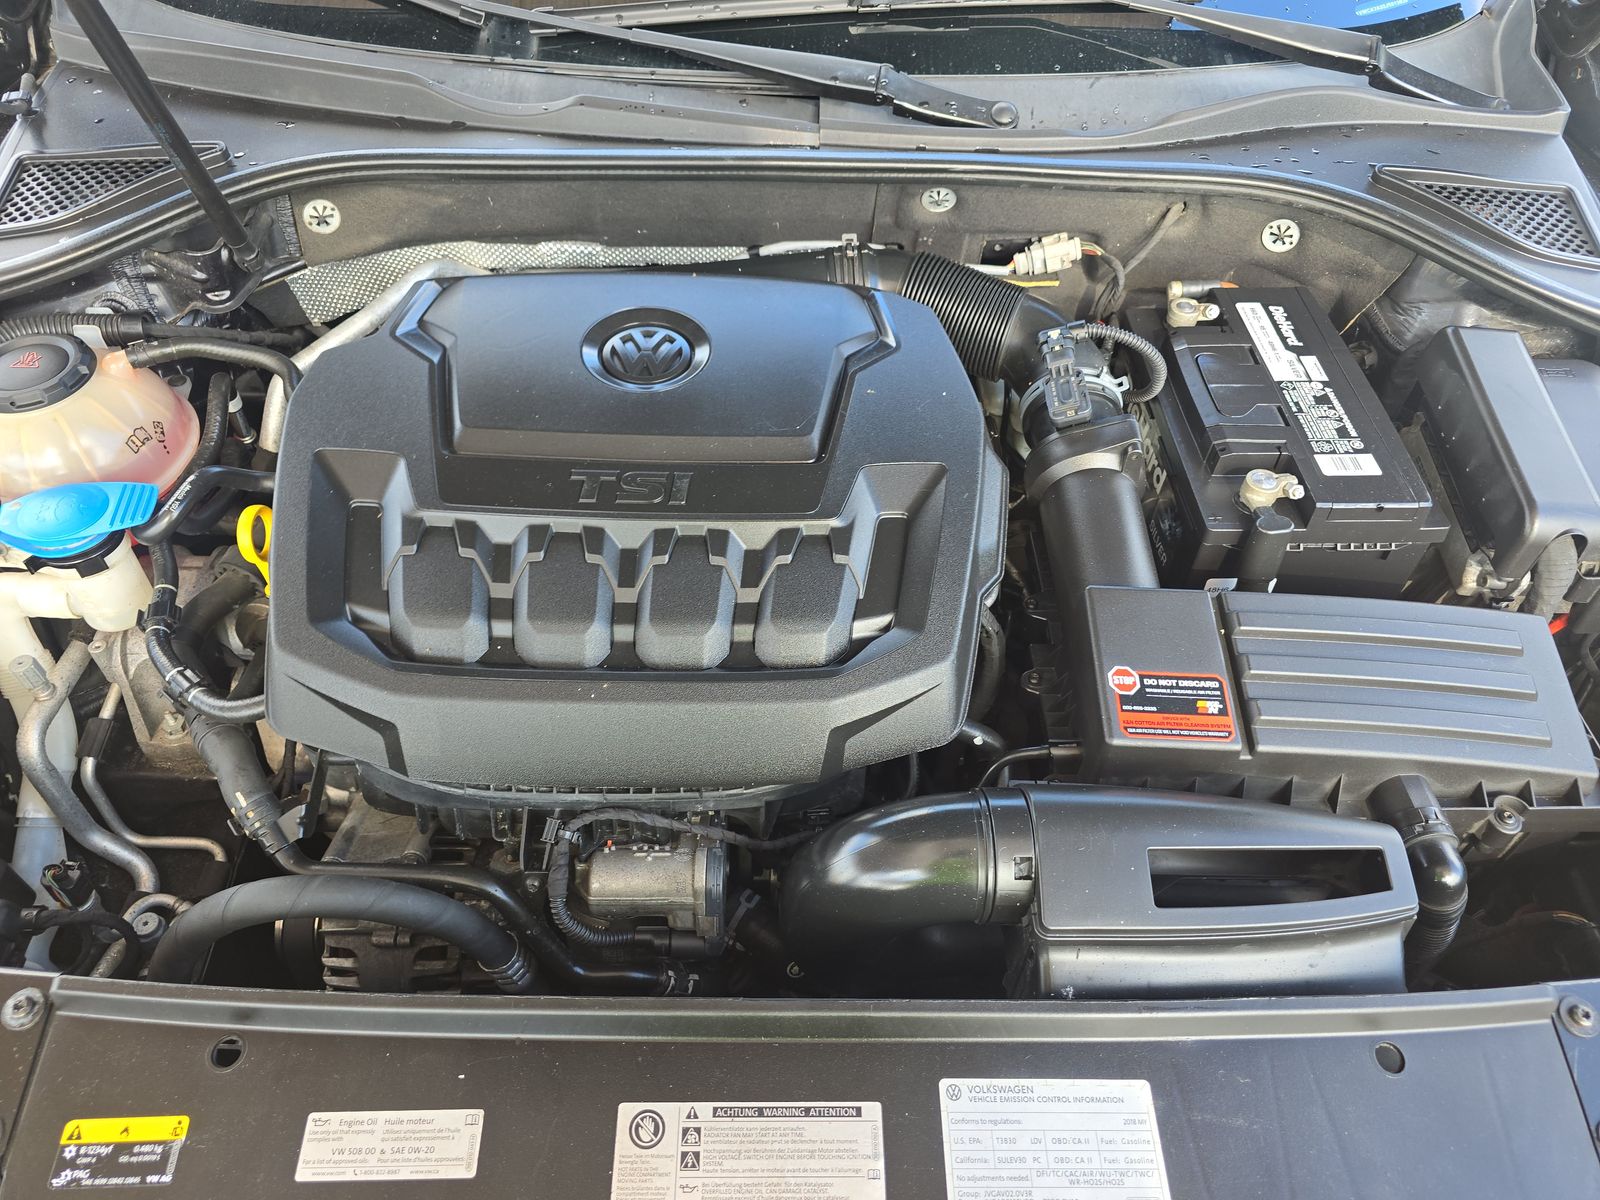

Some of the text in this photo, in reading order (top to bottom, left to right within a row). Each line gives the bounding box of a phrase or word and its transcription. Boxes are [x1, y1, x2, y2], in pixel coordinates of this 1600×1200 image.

[1268, 305, 1304, 346] DieHard
[1287, 359, 1302, 379] SILVER
[569, 468, 694, 505] TSI
[1150, 519, 1168, 566] SILVER
[1112, 675, 1136, 685] STOP
[1143, 678, 1219, 688] DO NOT DISCARD
[967, 1085, 1034, 1095] VOLKSWAGEN
[715, 1107, 857, 1116] ACHTUNG WARNING ATTENTION
[339, 1117, 378, 1128] Engine Oil
[384, 1117, 405, 1125] Huile
[950, 1117, 979, 1125] Conforms
[987, 1117, 1023, 1126] regulations:
[1122, 1118, 1147, 1126] 2018 MY
[1051, 1137, 1071, 1145] OBD:
[1072, 1137, 1082, 1145] CA
[1101, 1137, 1151, 1145] Fuel: Gasoline
[332, 1147, 346, 1155] VW
[347, 1147, 363, 1155] 508
[364, 1147, 377, 1155] 00
[390, 1146, 406, 1155] SAE
[407, 1145, 436, 1154] 0W-20
[954, 1156, 990, 1164] California:
[1032, 1156, 1042, 1164] PC
[1103, 1156, 1155, 1164] Fuel: Gasoline
[73, 1169, 91, 1179] PAG
[146, 1174, 173, 1183] VW AG
[956, 1174, 966, 1182] No
[967, 1174, 1004, 1183] adjustments
[957, 1190, 981, 1198] Group:
